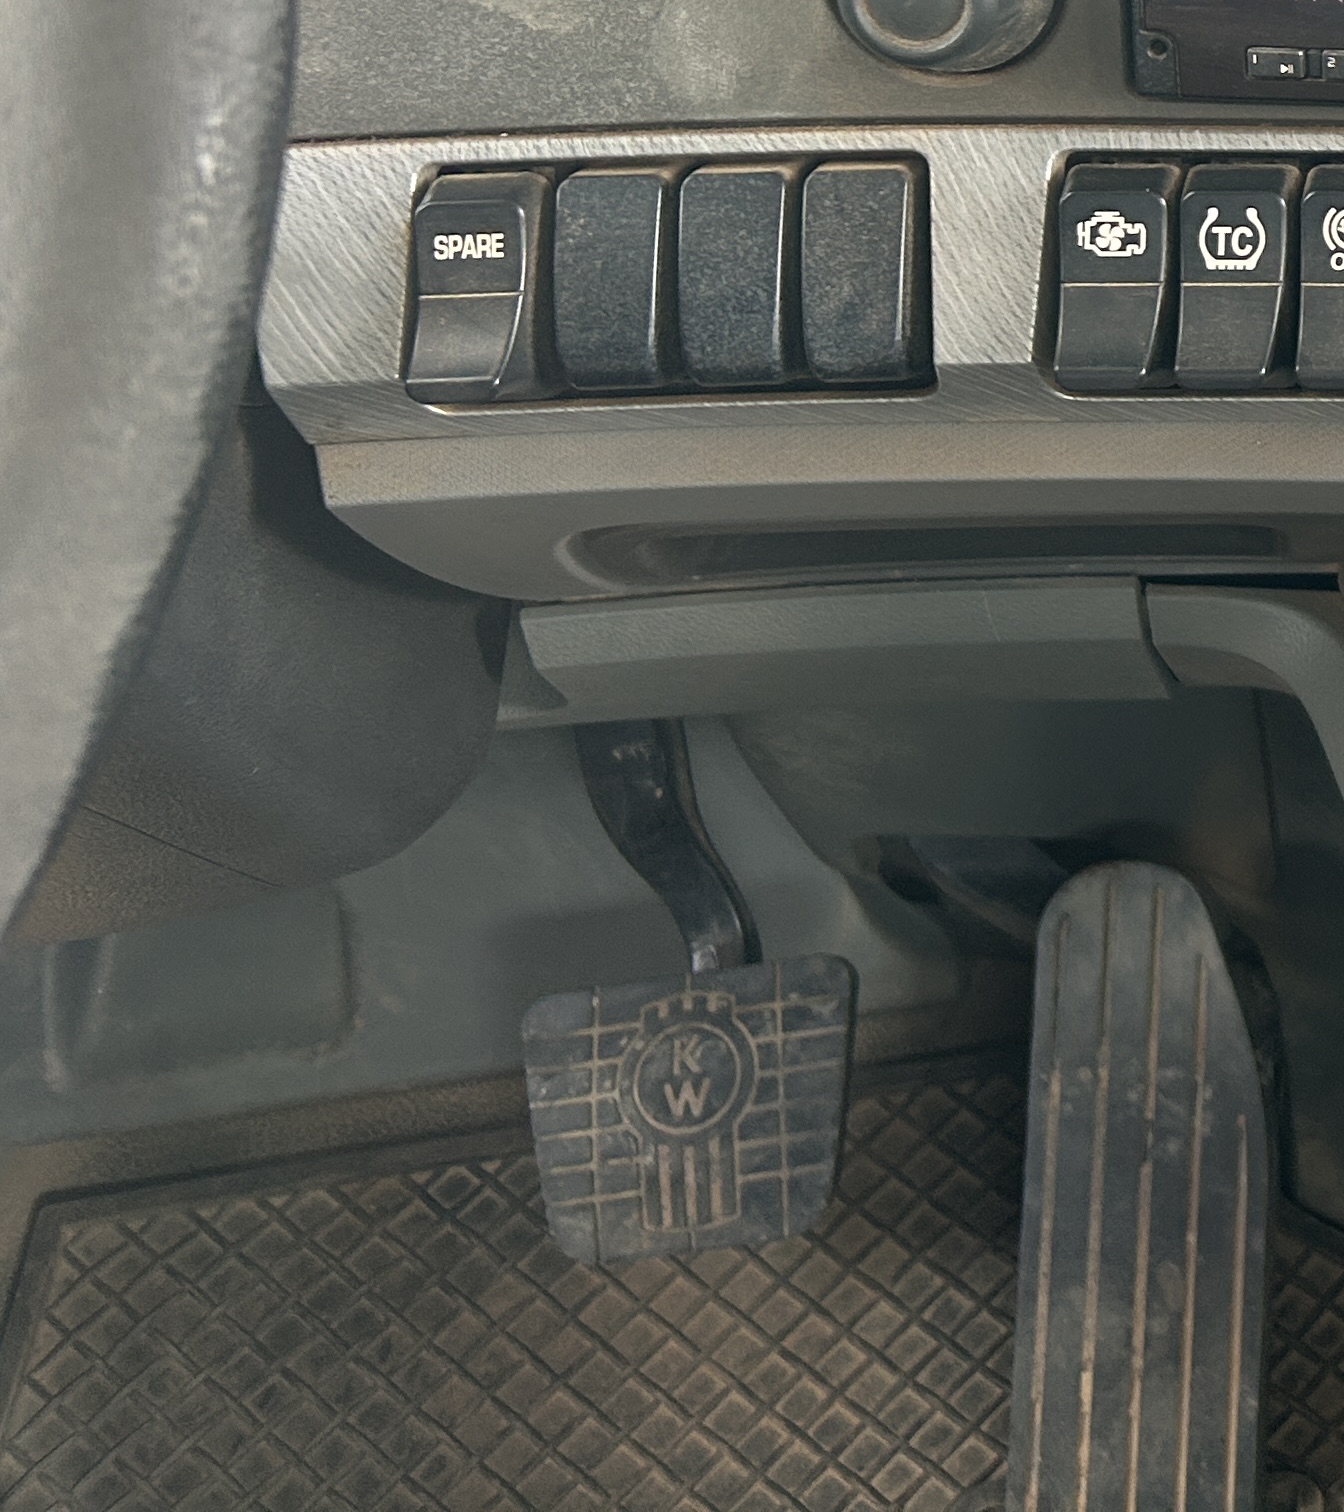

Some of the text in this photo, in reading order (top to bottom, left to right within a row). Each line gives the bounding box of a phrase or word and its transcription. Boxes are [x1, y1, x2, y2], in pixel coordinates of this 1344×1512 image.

[1327, 56, 1336, 68] 2
[433, 232, 505, 261] SPARE
[1211, 226, 1255, 257] TC
[672, 1036, 701, 1075] K
[664, 1077, 712, 1118] W
